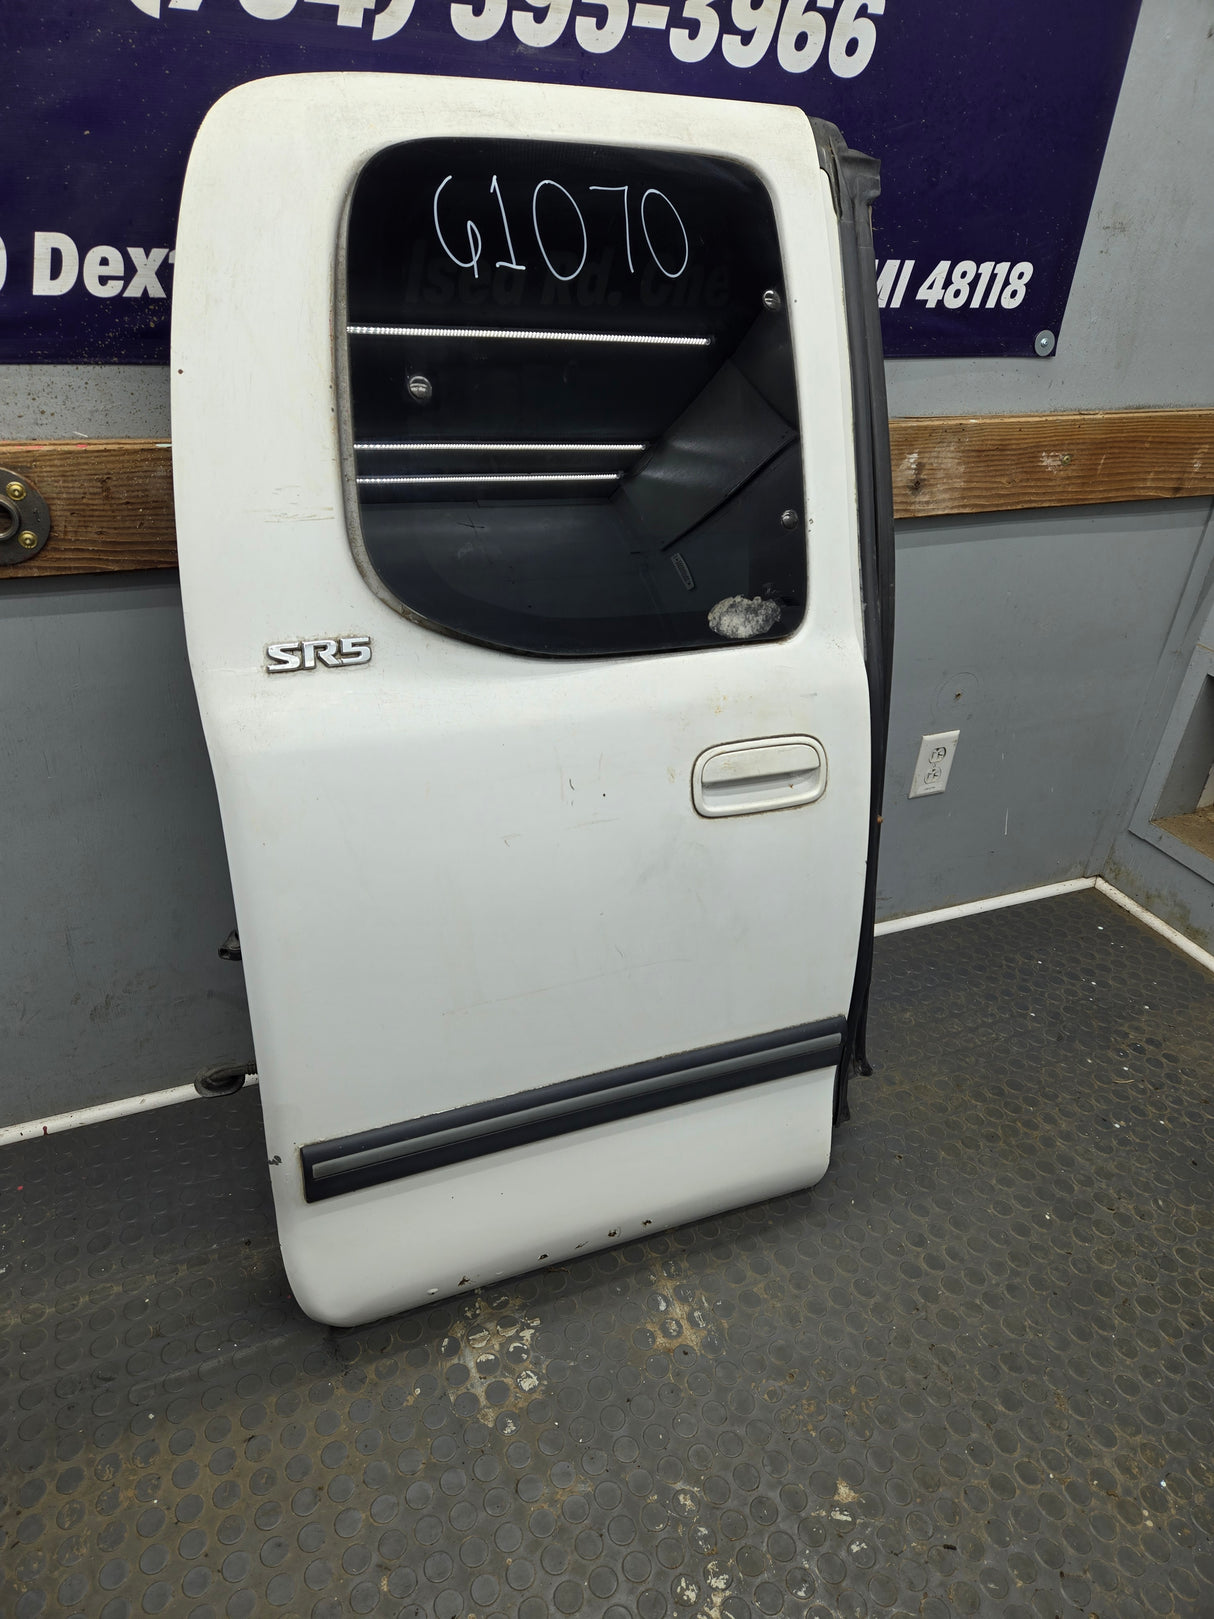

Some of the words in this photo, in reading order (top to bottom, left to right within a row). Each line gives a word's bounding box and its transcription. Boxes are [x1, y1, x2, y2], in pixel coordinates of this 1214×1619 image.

[32, 231, 176, 298] Dex
[916, 260, 1034, 309] 48118
[267, 637, 373, 673] SR5
